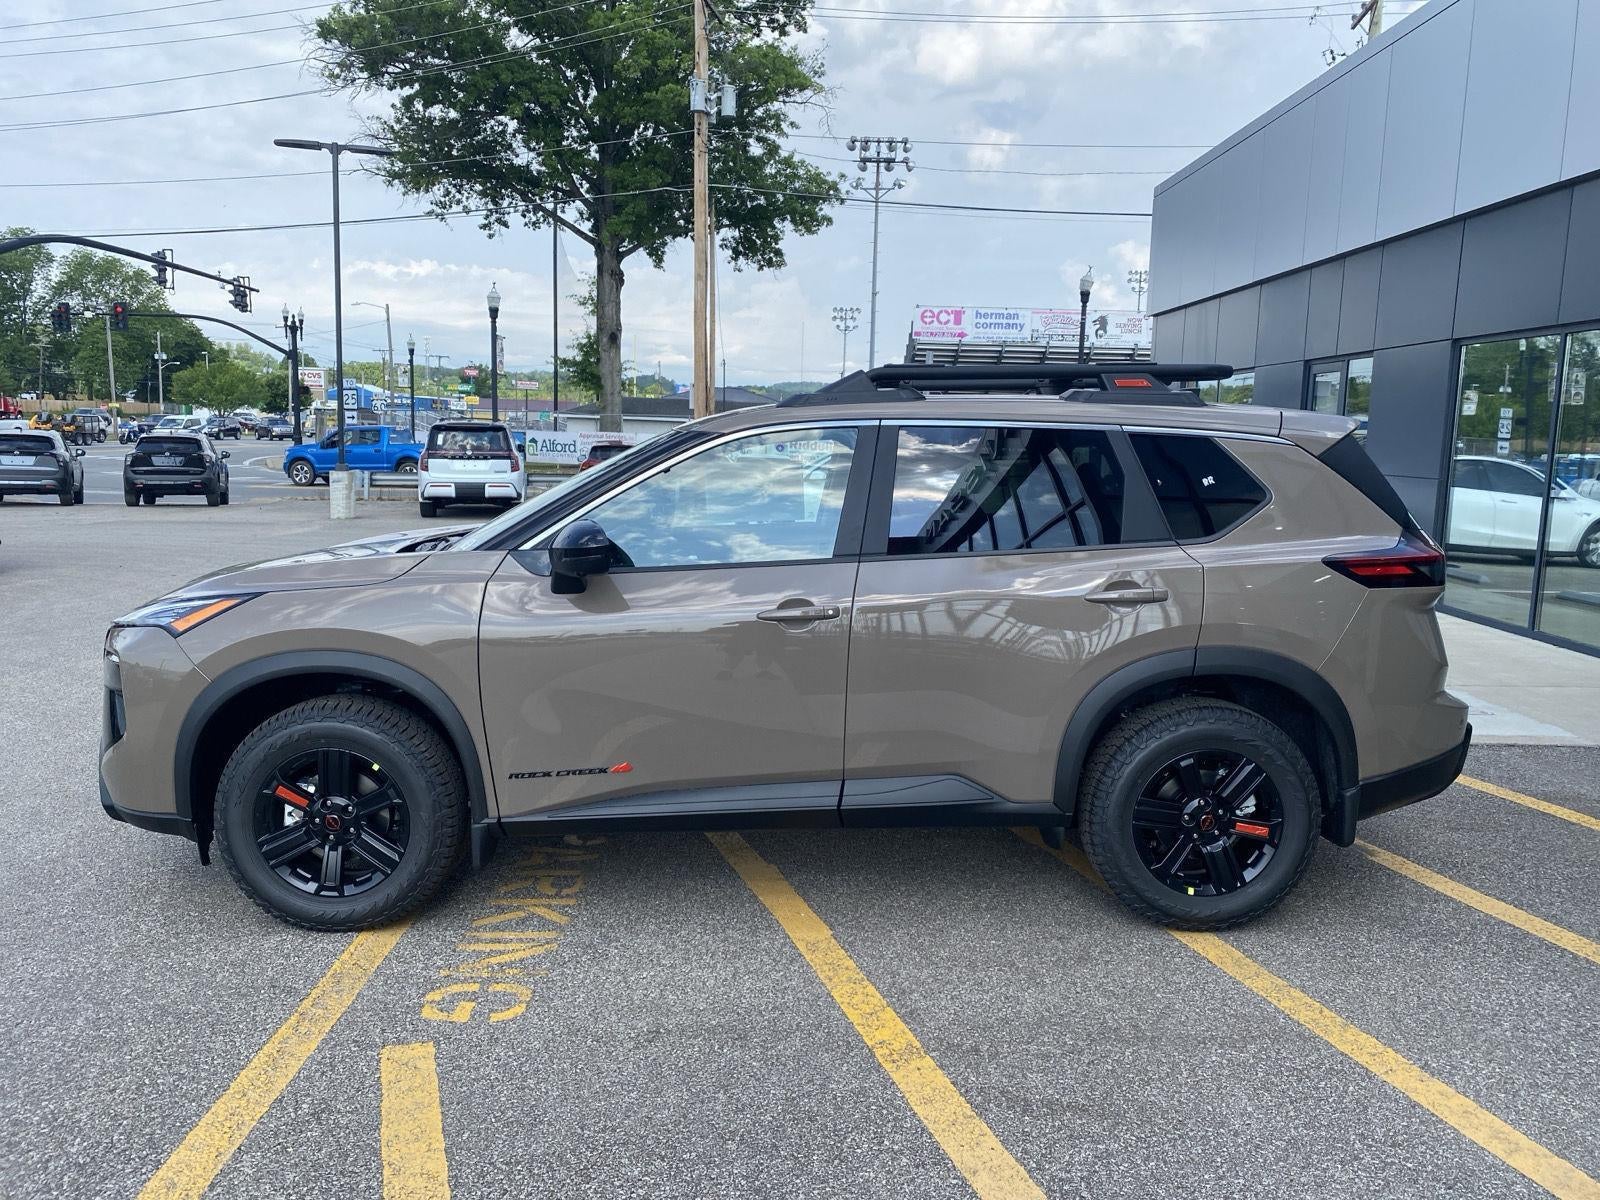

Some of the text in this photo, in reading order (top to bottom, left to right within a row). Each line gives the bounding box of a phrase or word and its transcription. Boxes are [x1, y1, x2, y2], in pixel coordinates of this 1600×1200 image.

[975, 309, 1020, 320] herman
[974, 320, 1026, 332] cormany
[307, 371, 322, 379] CVS
[343, 393, 357, 406] 25
[373, 402, 386, 411] 60
[540, 438, 577, 454] Alford
[508, 766, 609, 780] ROCK CREEK
